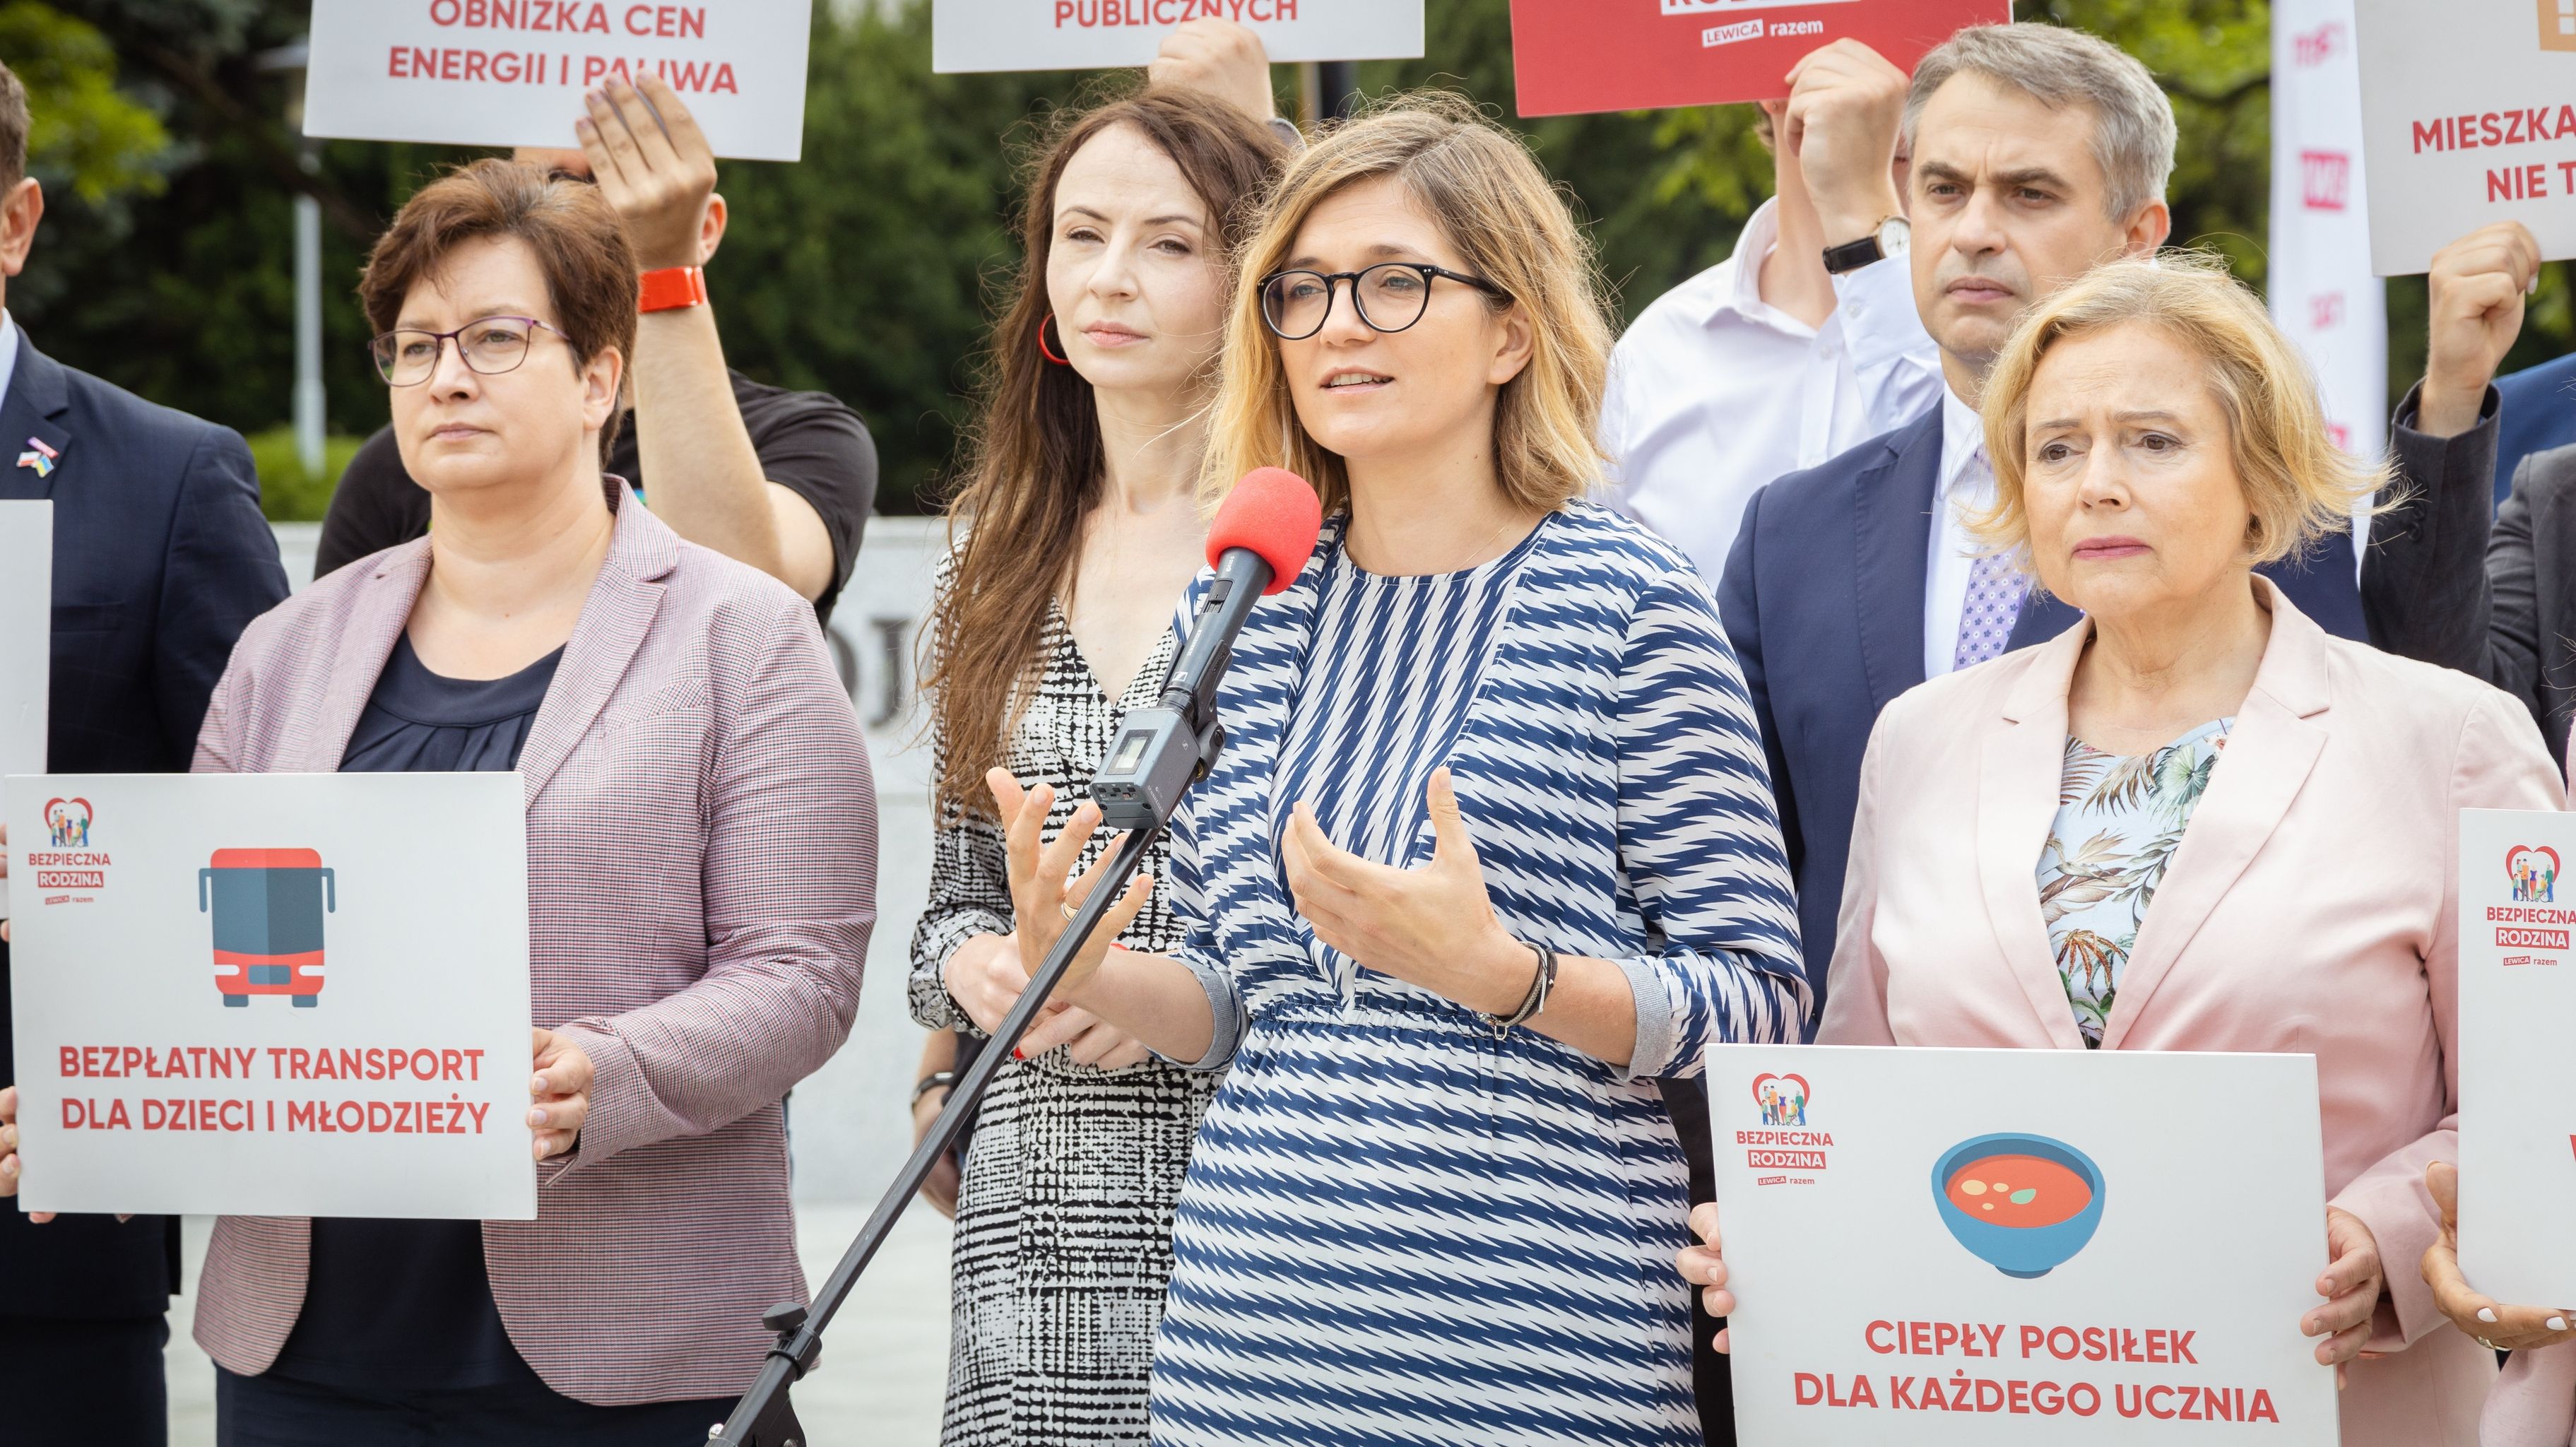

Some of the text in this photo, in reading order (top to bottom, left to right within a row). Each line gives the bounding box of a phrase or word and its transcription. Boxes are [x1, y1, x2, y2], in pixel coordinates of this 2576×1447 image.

[624, 4, 706, 39] CEN
[1706, 20, 1824, 43] LEWICA razem
[389, 46, 546, 84] ENERGII
[560, 55, 569, 85] I
[2486, 164, 2548, 203] NIE
[28, 853, 112, 866] BEZPIECZNA
[40, 873, 102, 887] RODZINA
[2486, 906, 2576, 925] BEZPIECZNA
[2498, 929, 2568, 947] RODZINA
[2504, 956, 2558, 967] LEWICA razem
[59, 1046, 485, 1081] BEZPŁATNY TRANSPORT
[61, 1093, 490, 1134] DLA DZIECI I MŁODZIEŻY
[1736, 1130, 1834, 1146] BEZPIECZNA
[1750, 1152, 1824, 1167] RODZINA
[1759, 1176, 1785, 1185] LEWICA
[1865, 1320, 2197, 1364] CIEPŁY POSIŁEK
[1794, 1369, 2279, 1423] DLA KAŻDEGO UCZNIA
